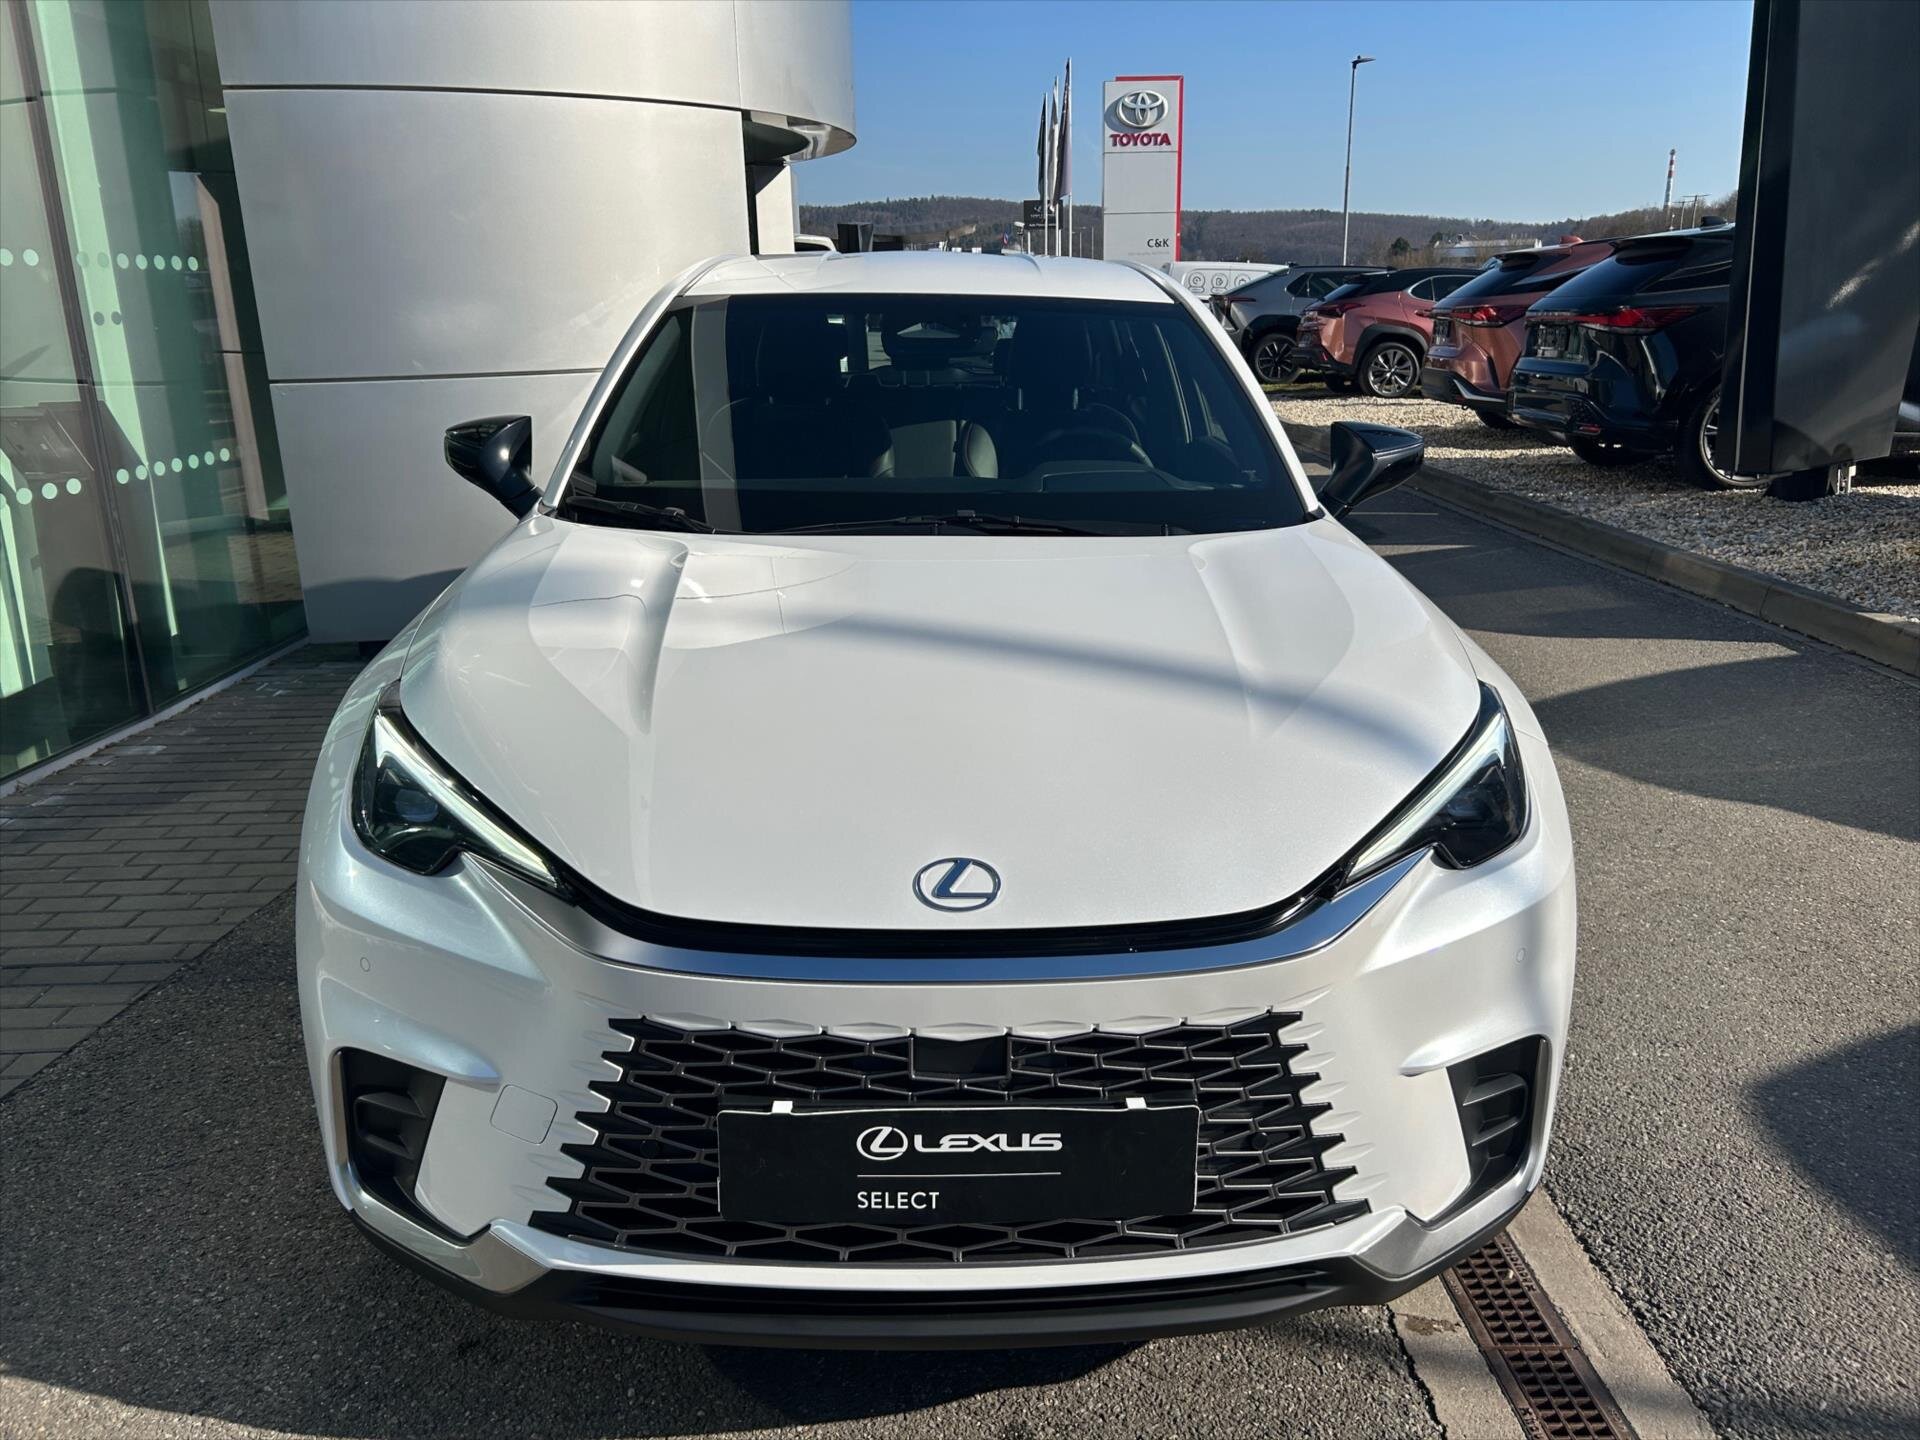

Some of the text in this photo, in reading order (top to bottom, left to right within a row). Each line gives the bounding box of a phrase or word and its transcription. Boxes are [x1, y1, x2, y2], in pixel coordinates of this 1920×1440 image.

[1110, 133, 1172, 147] TOYOTA
[1147, 238, 1170, 248] C&K
[914, 1132, 1063, 1153] LEXUS
[857, 1191, 940, 1210] SELECT
